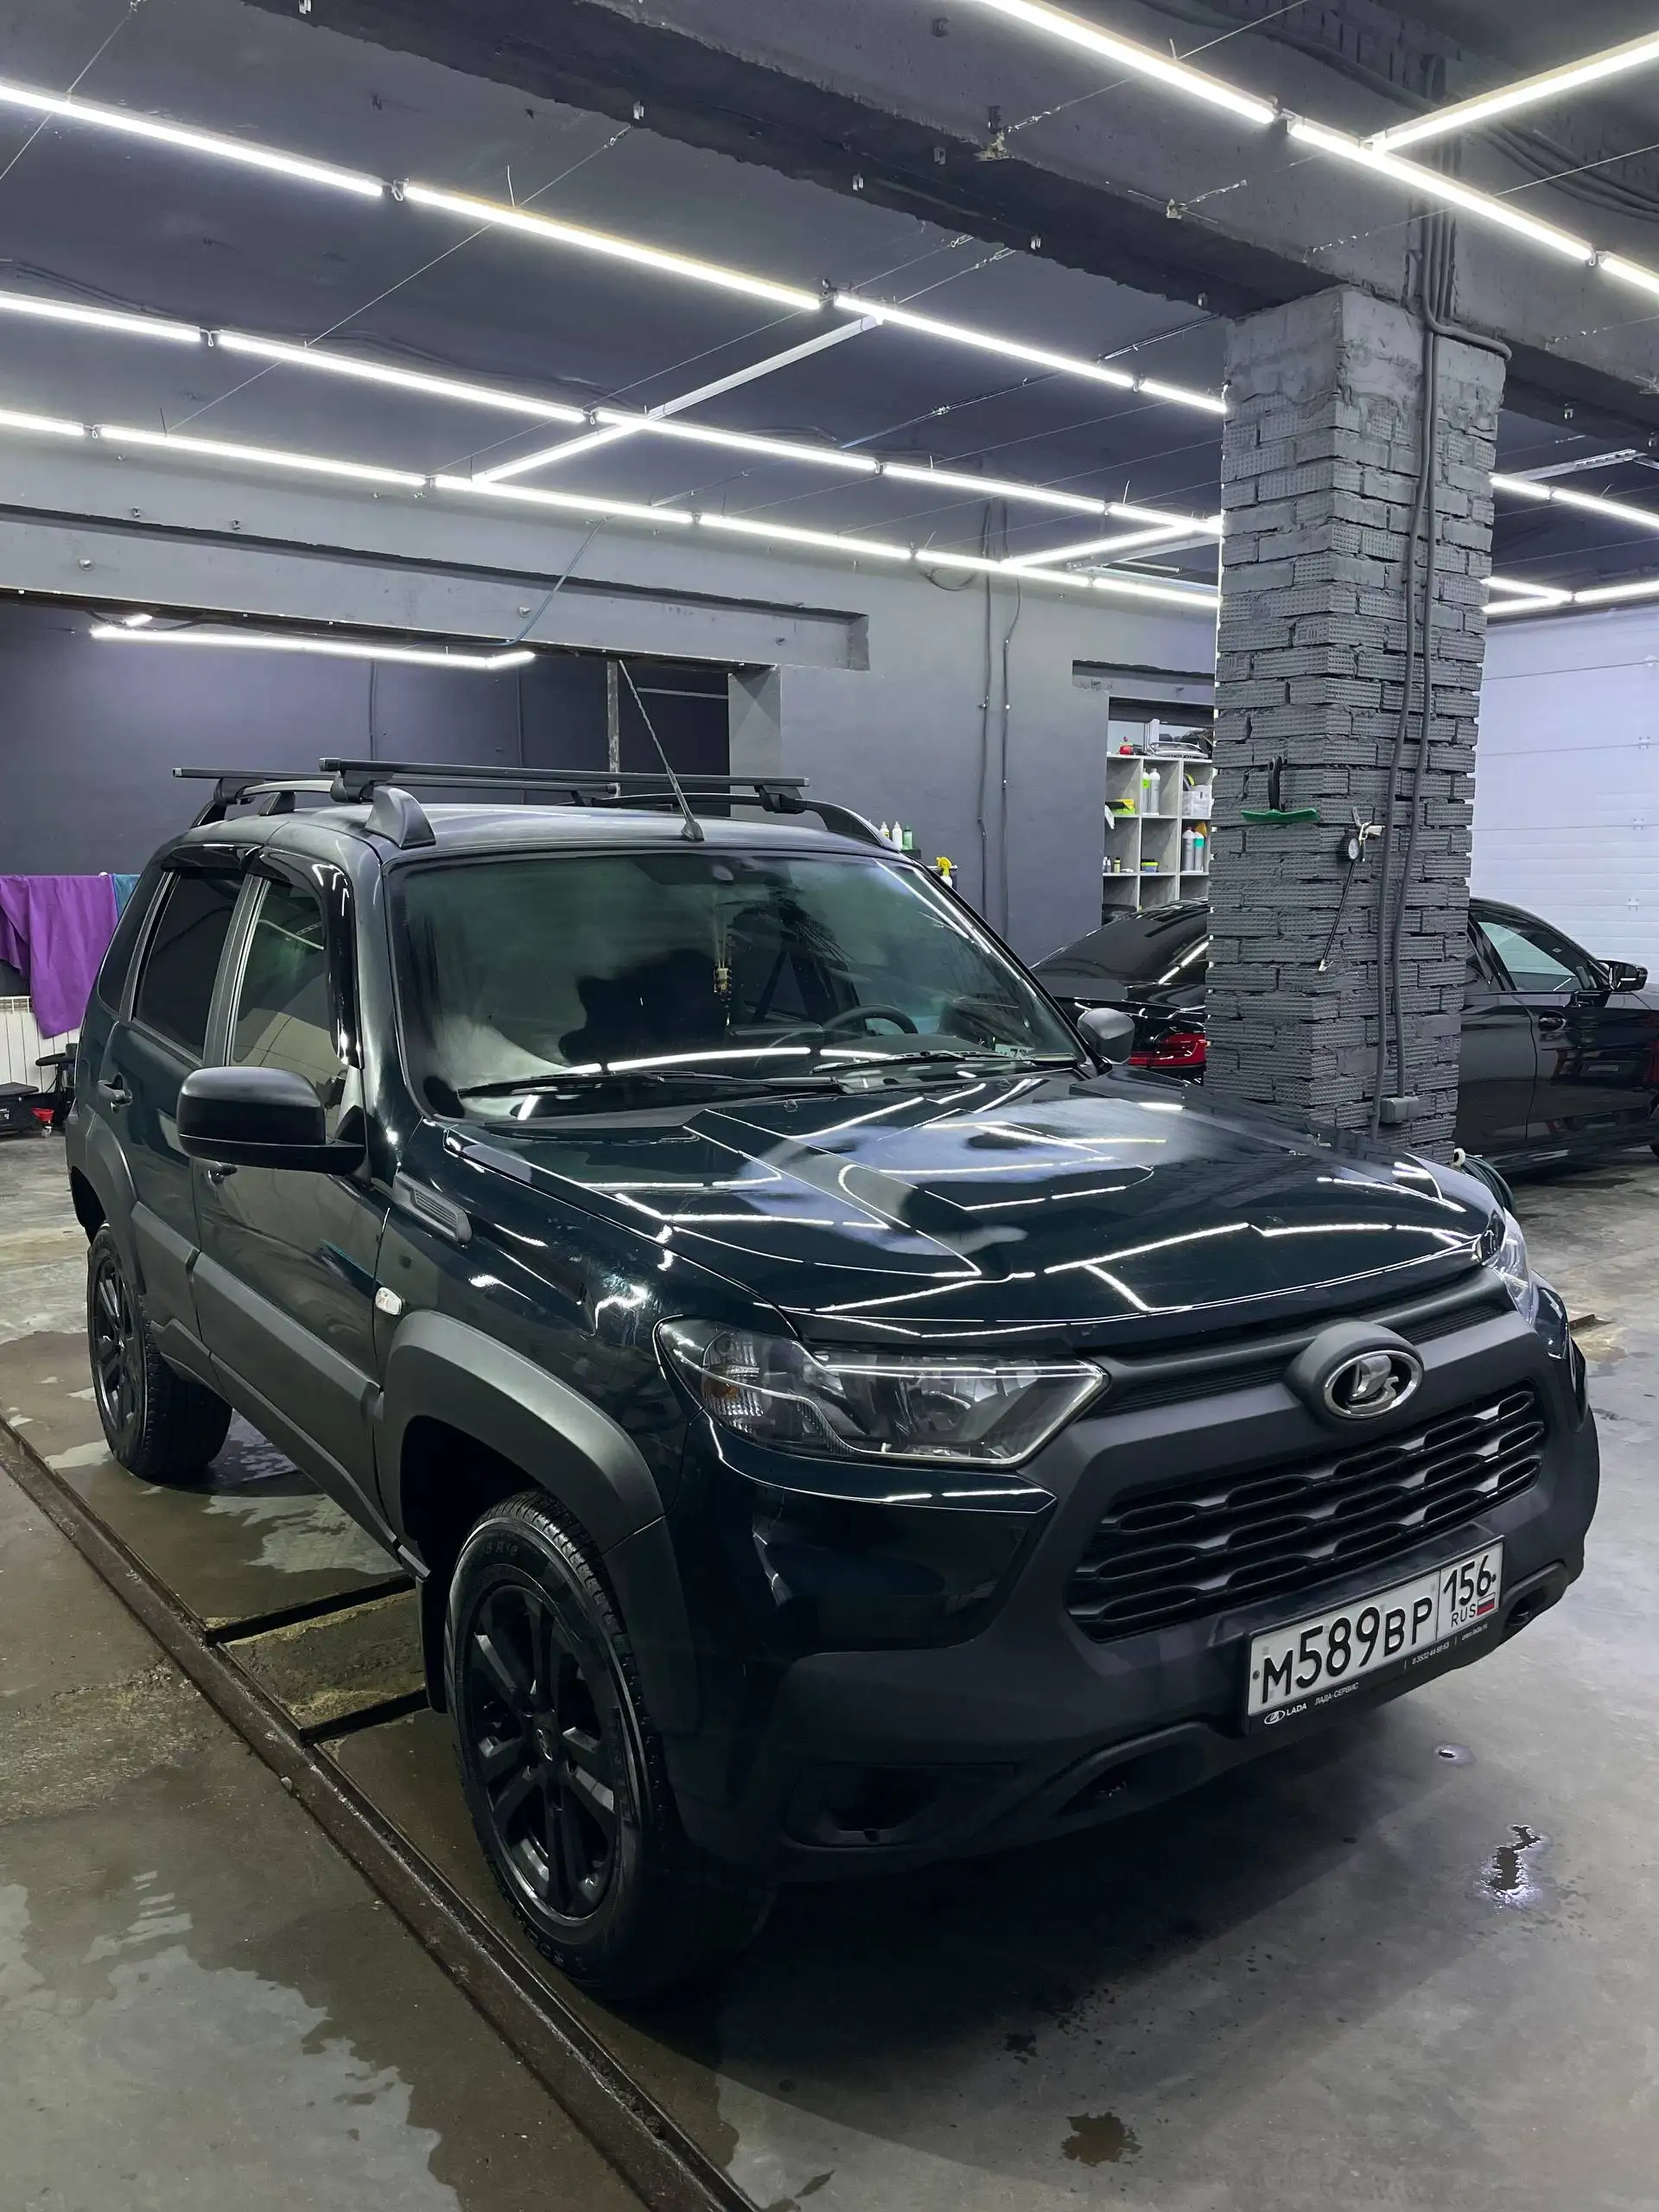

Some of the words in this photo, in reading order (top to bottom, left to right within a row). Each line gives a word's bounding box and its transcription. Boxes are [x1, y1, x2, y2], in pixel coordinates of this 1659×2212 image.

[1451, 1603, 1477, 1628] RUS
[1262, 1597, 1433, 1704] М589ВР
[1442, 1554, 1492, 1611] 156
[1286, 1702, 1307, 1716] LADA
